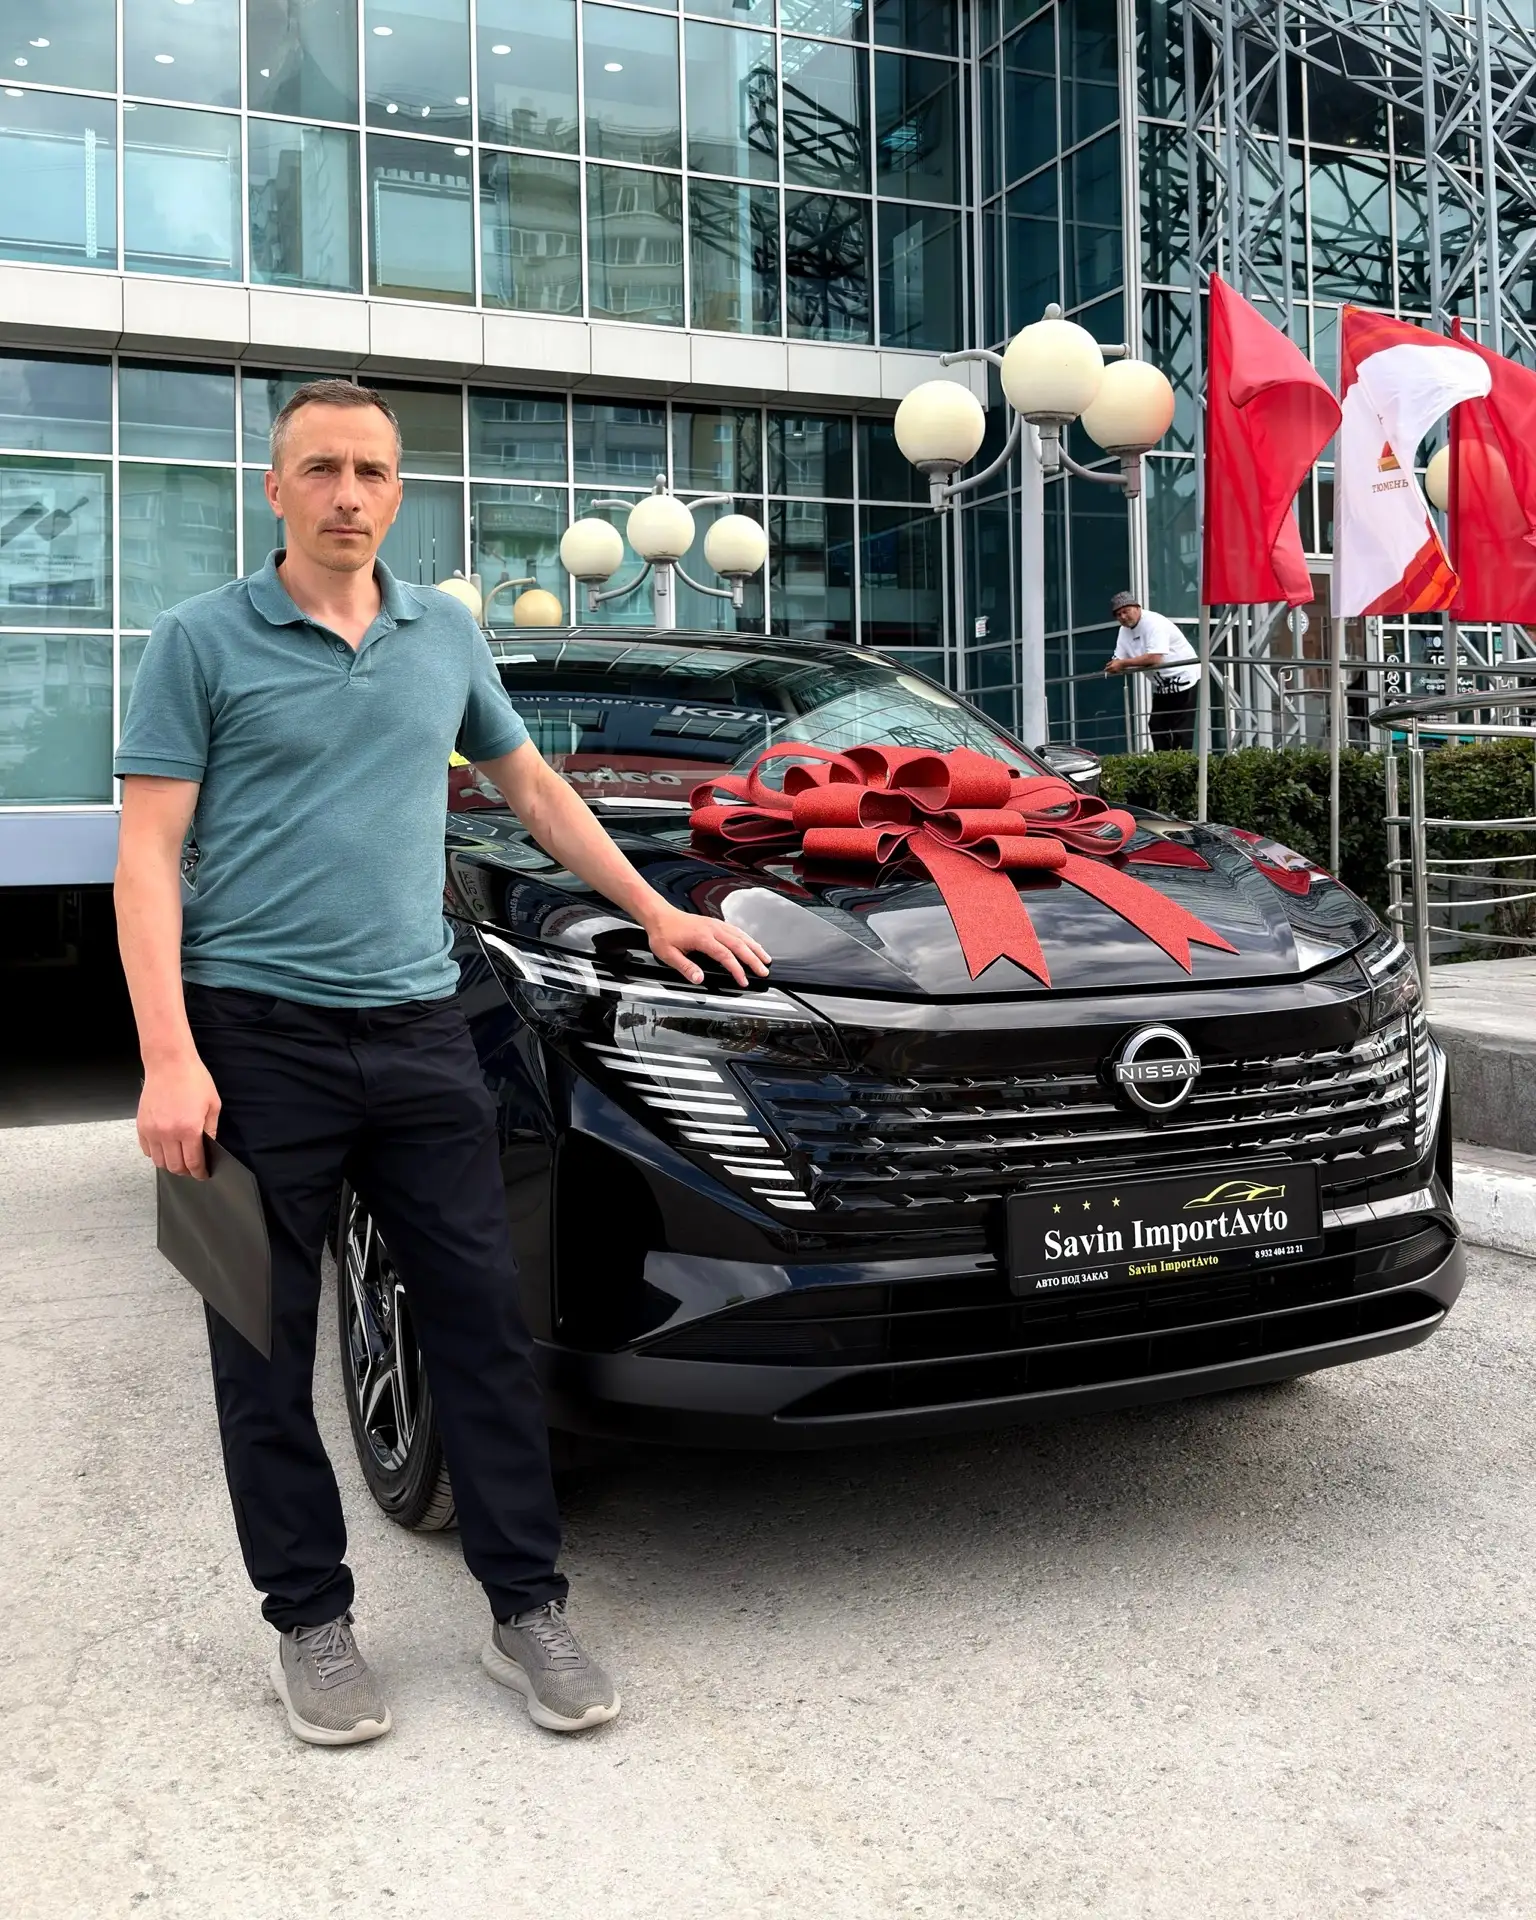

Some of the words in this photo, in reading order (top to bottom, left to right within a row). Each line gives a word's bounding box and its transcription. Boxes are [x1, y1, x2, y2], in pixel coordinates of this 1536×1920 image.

[1371, 479, 1409, 493] ТЮМЕНЬ
[1119, 1062, 1200, 1080] NISSAN
[1044, 1224, 1124, 1260] Savin
[1132, 1207, 1288, 1251] ImportAvto
[1254, 1250, 1260, 1259] 8
[1260, 1248, 1273, 1258] 932
[1273, 1246, 1286, 1256] 404
[1286, 1245, 1295, 1254] 22
[1295, 1244, 1304, 1253] 21
[1128, 1262, 1158, 1276] Savin
[1160, 1255, 1219, 1272] ImportAvto
[1035, 1277, 1060, 1289] АВТО
[1061, 1274, 1081, 1286] ПОД
[1081, 1270, 1109, 1283] ЗАКАЗ
